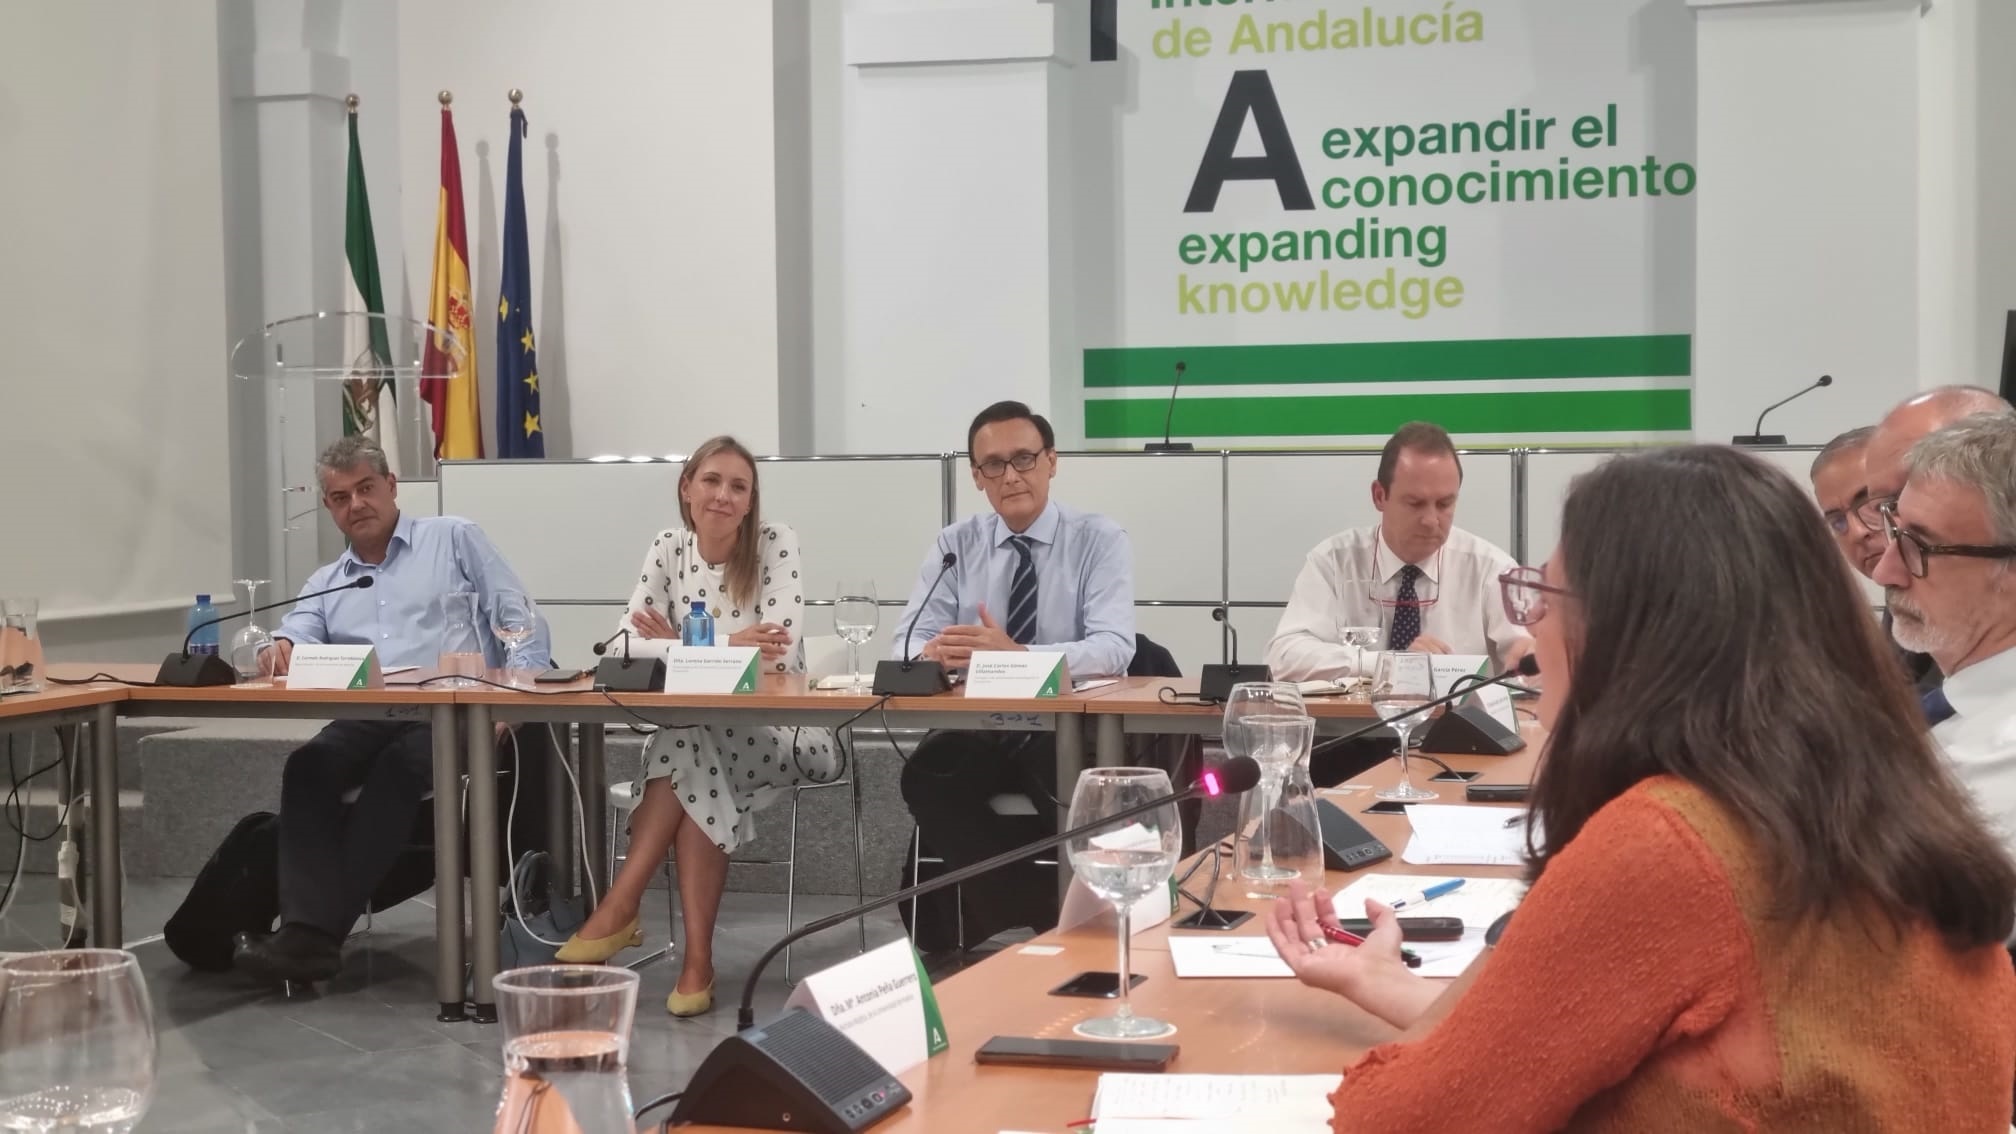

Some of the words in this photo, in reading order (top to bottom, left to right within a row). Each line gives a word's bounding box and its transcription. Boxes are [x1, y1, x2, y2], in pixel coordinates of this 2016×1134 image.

[1153, 19, 1212, 58] de
[1230, 4, 1482, 54] Andalucía
[1183, 69, 1316, 212] A
[1322, 109, 1557, 165] expandir
[1571, 103, 1617, 147] el
[1322, 156, 1697, 208] conocimiento
[1178, 217, 1447, 272] expanding
[1178, 267, 1465, 319] knowledge
